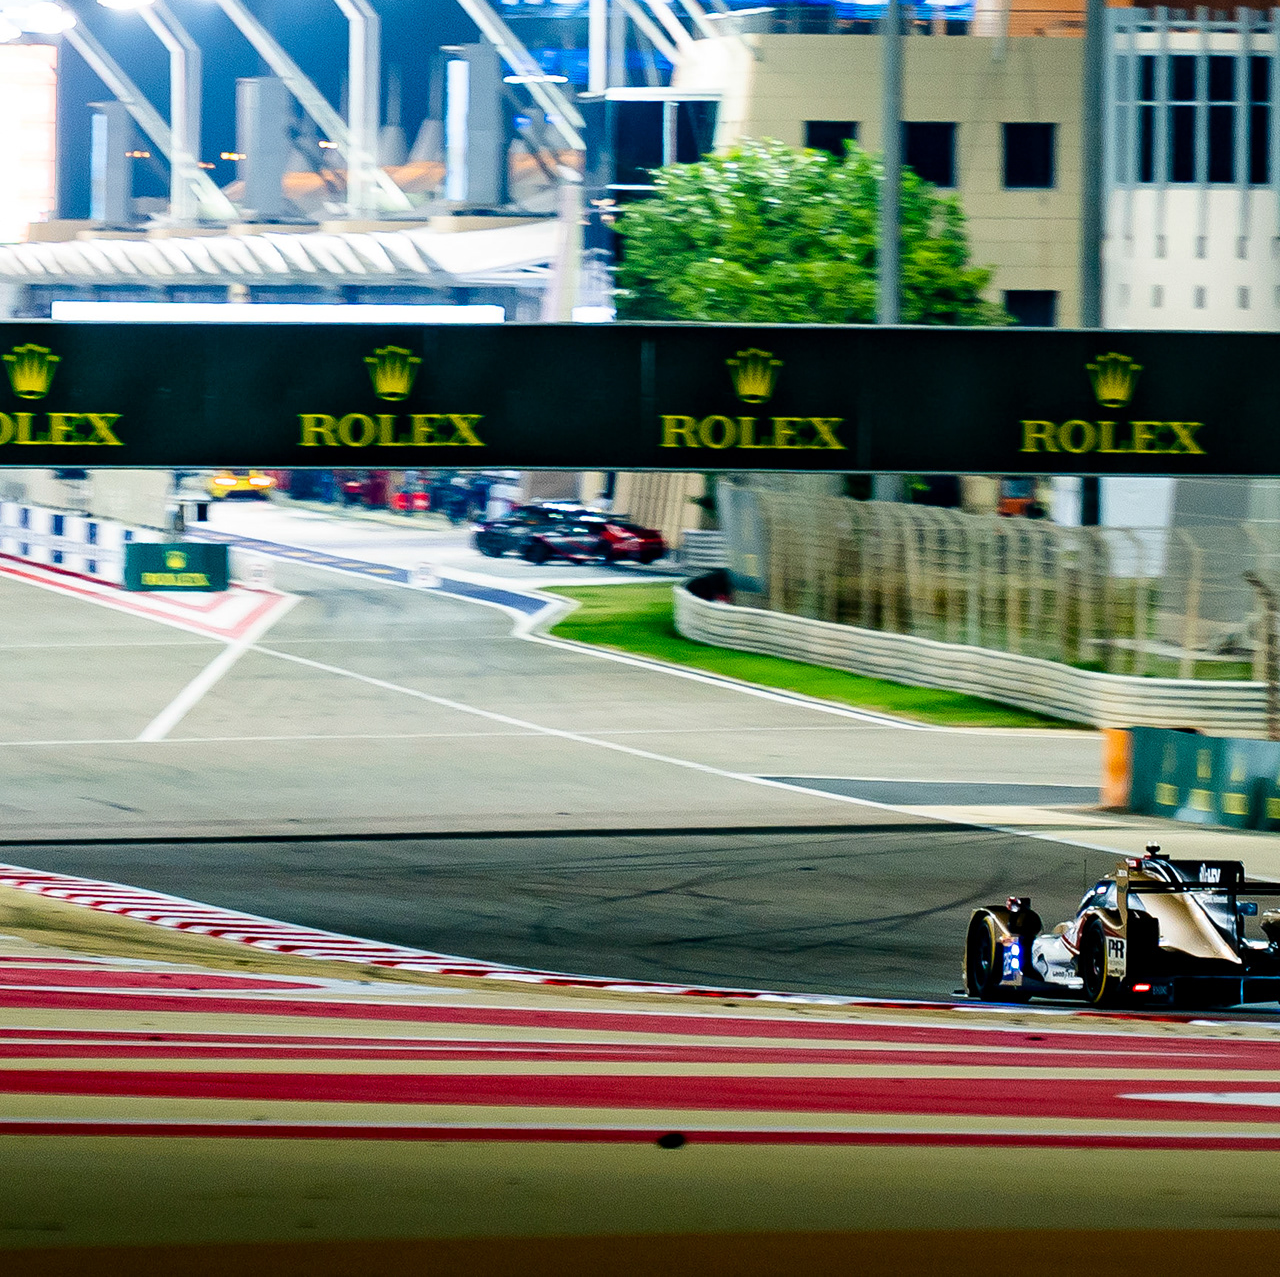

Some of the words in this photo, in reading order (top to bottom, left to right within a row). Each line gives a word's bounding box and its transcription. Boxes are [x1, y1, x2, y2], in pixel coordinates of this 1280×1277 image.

[299, 412, 485, 447] ROLEX
[660, 413, 845, 450] ROLEX
[1020, 418, 1204, 455] ROLEX
